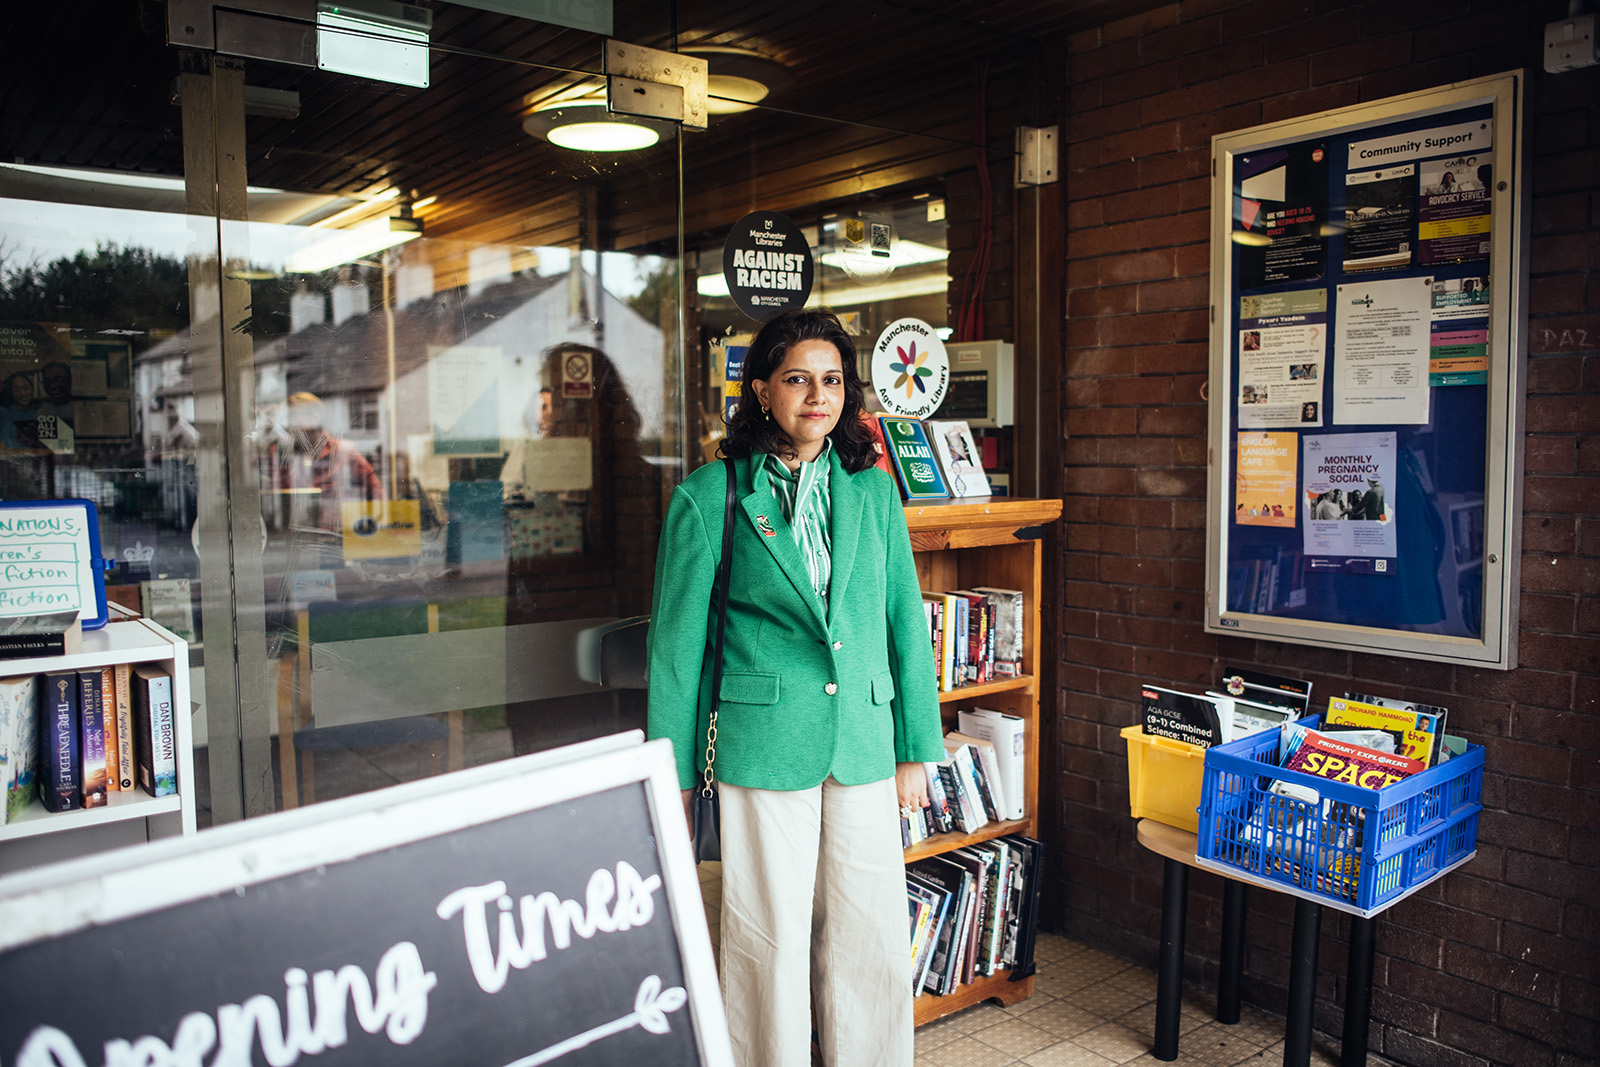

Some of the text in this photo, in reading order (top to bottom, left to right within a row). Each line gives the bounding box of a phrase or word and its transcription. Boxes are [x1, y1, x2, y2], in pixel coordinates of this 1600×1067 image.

[1360, 132, 1472, 158] Community Support
[1429, 190, 1486, 206] ADVOCACY SERVICE
[1266, 214, 1315, 228] AND NEEDING HOUSING
[1267, 212, 1276, 220] ARE
[1276, 210, 1285, 218] YOU
[1286, 208, 1298, 217] AGED
[750, 230, 786, 240] Manchester
[1266, 228, 1285, 236] ADVICE?
[756, 237, 783, 247] Libraries
[733, 248, 804, 272] AGAINST
[736, 268, 802, 290] RACISM
[1436, 298, 1472, 306] EMPLOYMENT
[878, 324, 930, 352] Manchester
[879, 365, 948, 417] Age Friendly Library
[37, 414, 56, 423] GO
[38, 422, 56, 430] ALL
[39, 430, 56, 438] IN.
[1241, 438, 1276, 446] ENGLISH
[899, 446, 931, 458] ALLAH
[1240, 448, 1288, 456] LANGUAGE
[1240, 458, 1263, 466] CAFE
[1324, 455, 1372, 465] MONTHLY
[1318, 464, 1379, 474] PREGNANCY
[1329, 474, 1364, 483] SOCIAL
[0, 591, 68, 608] fiction
[102, 668, 110, 692] Katie
[82, 679, 95, 726] JEFFERIES
[1147, 706, 1182, 720] AQA GCSE
[1348, 706, 1414, 724] RICHARD HAMMOND
[160, 702, 172, 760] DAN BROWN
[1147, 715, 1212, 738] (9-1) Combined
[57, 701, 71, 782] THREADNEEDLE
[1147, 726, 1211, 748] Science: Trilogy
[1408, 731, 1426, 743] the
[1317, 739, 1409, 768] PRIMARY EXPLORERS
[941, 798, 950, 814] RED
[436, 860, 662, 994] Times
